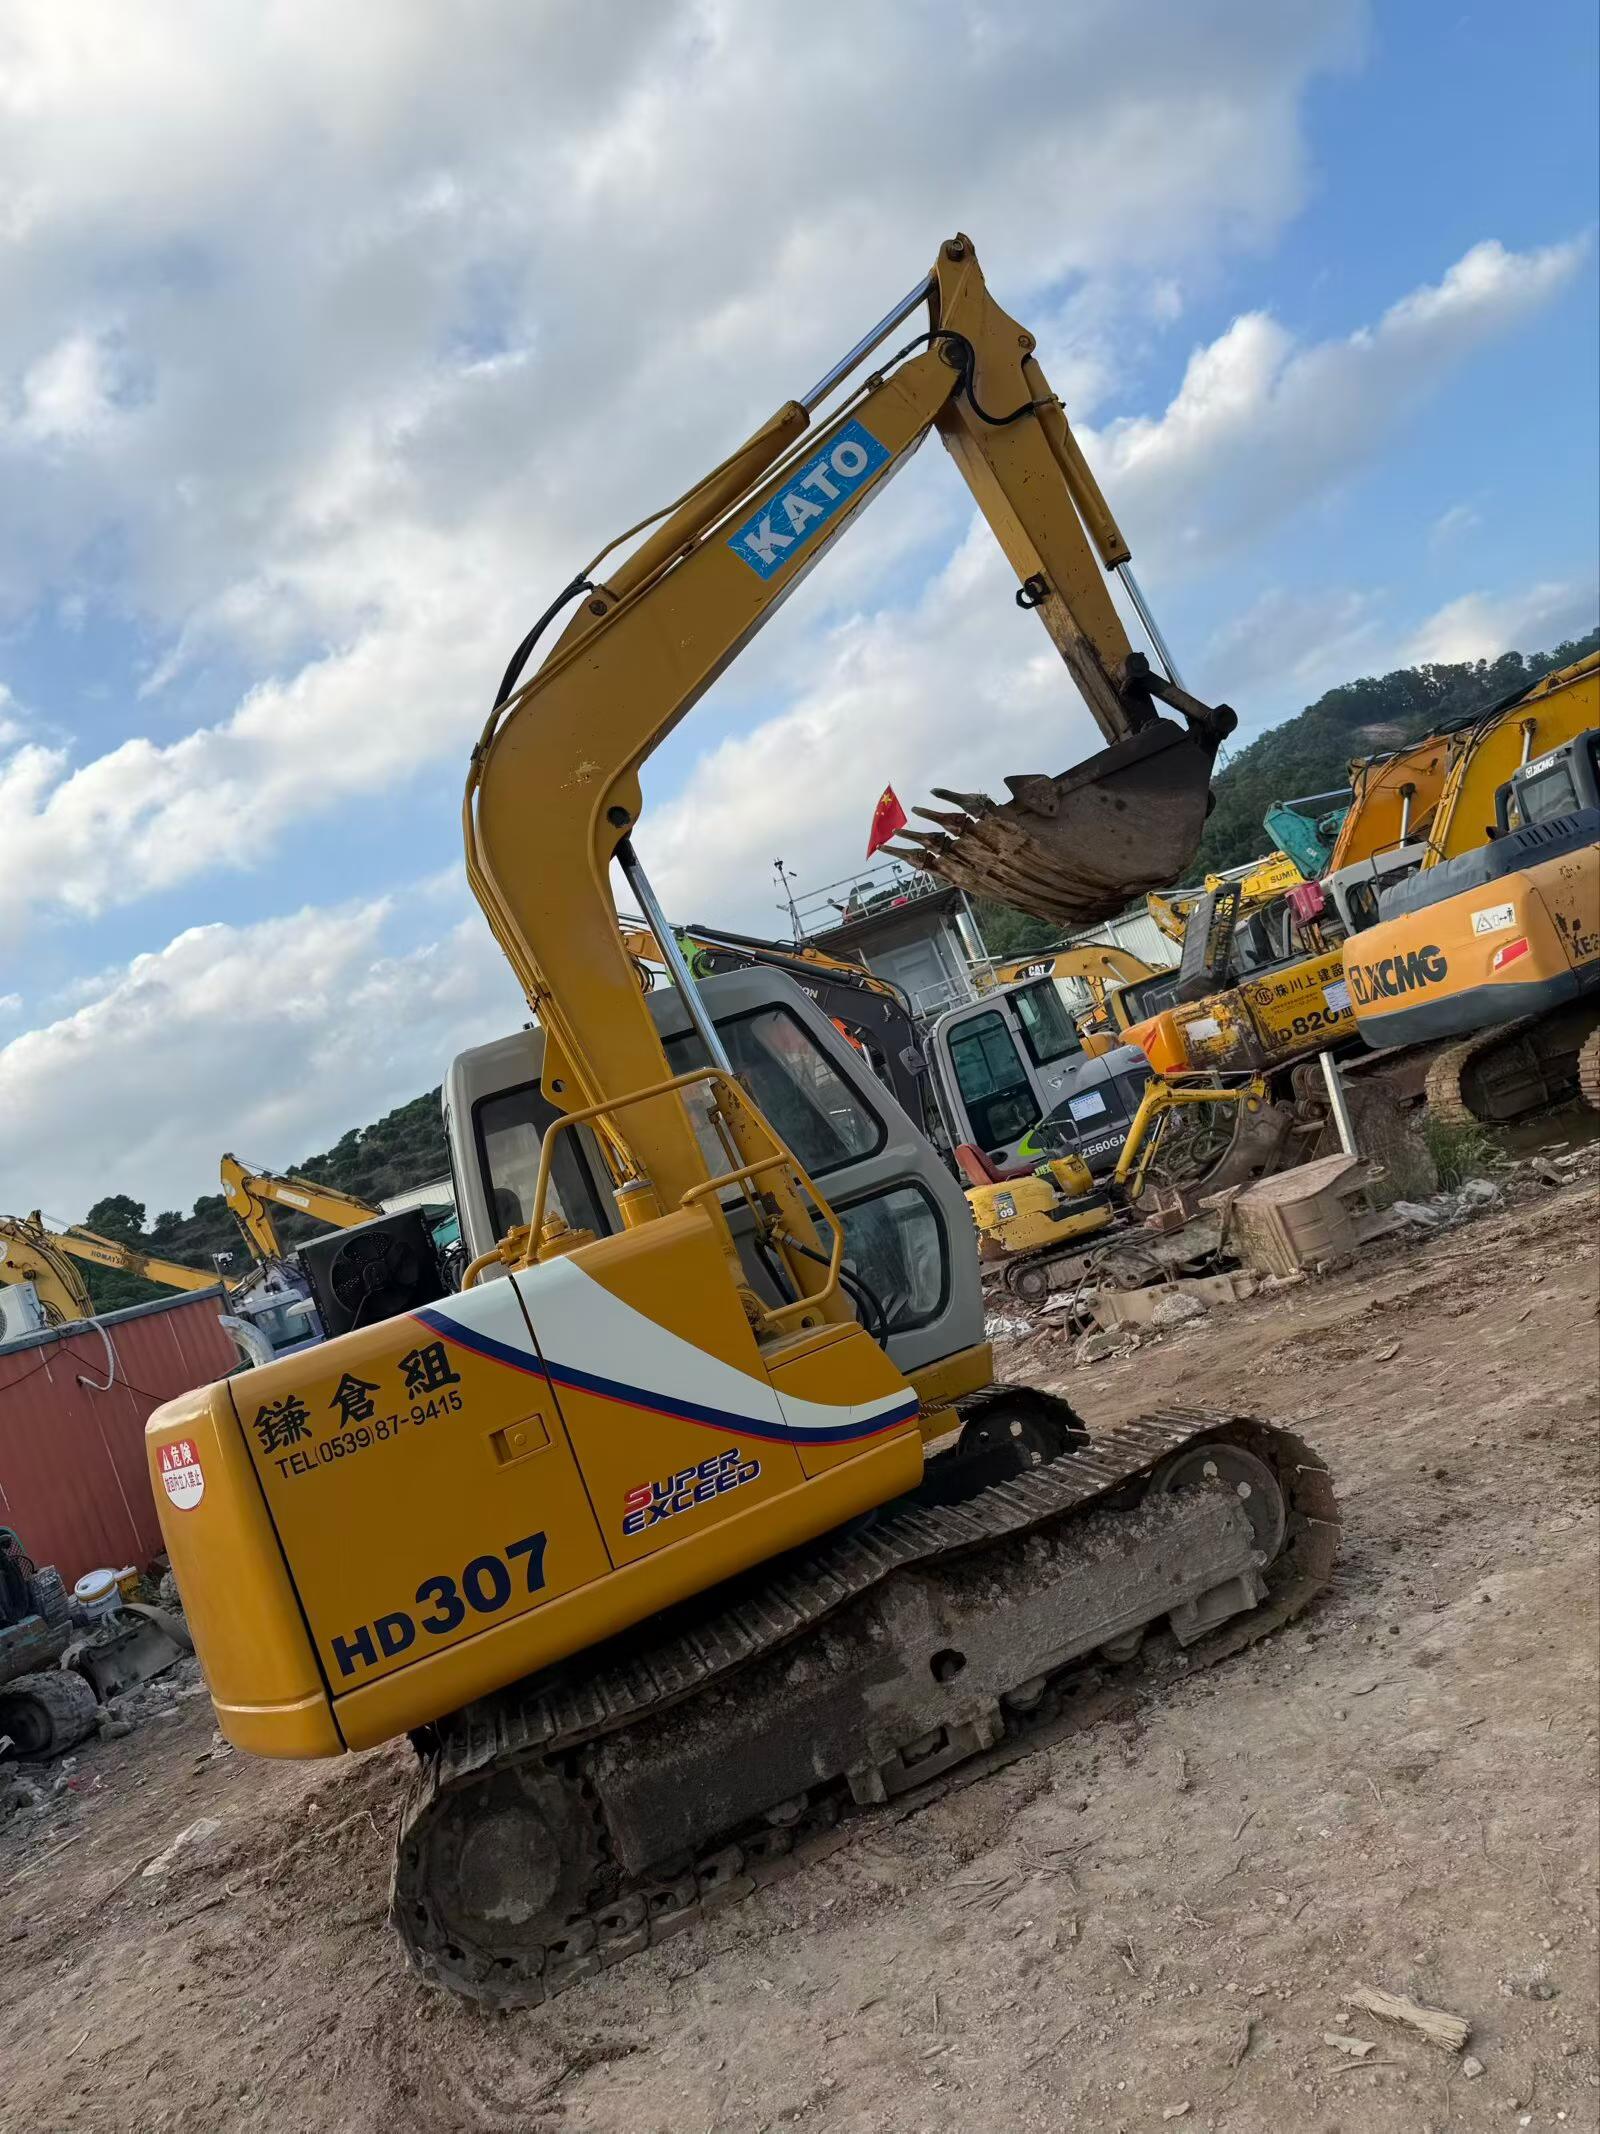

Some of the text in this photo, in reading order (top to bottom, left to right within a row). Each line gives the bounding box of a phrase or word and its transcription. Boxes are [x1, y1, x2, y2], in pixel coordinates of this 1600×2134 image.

[743, 441, 868, 565] KATO
[1533, 757, 1554, 775] XCMG
[1028, 964, 1045, 976] CAT
[1364, 945, 1448, 1001] XCMG
[1000, 1208, 1014, 1218] 09
[253, 1341, 461, 1455] 鎌倉組
[622, 1459, 761, 1536] EXCEED
[624, 1447, 741, 1517] SUPER
